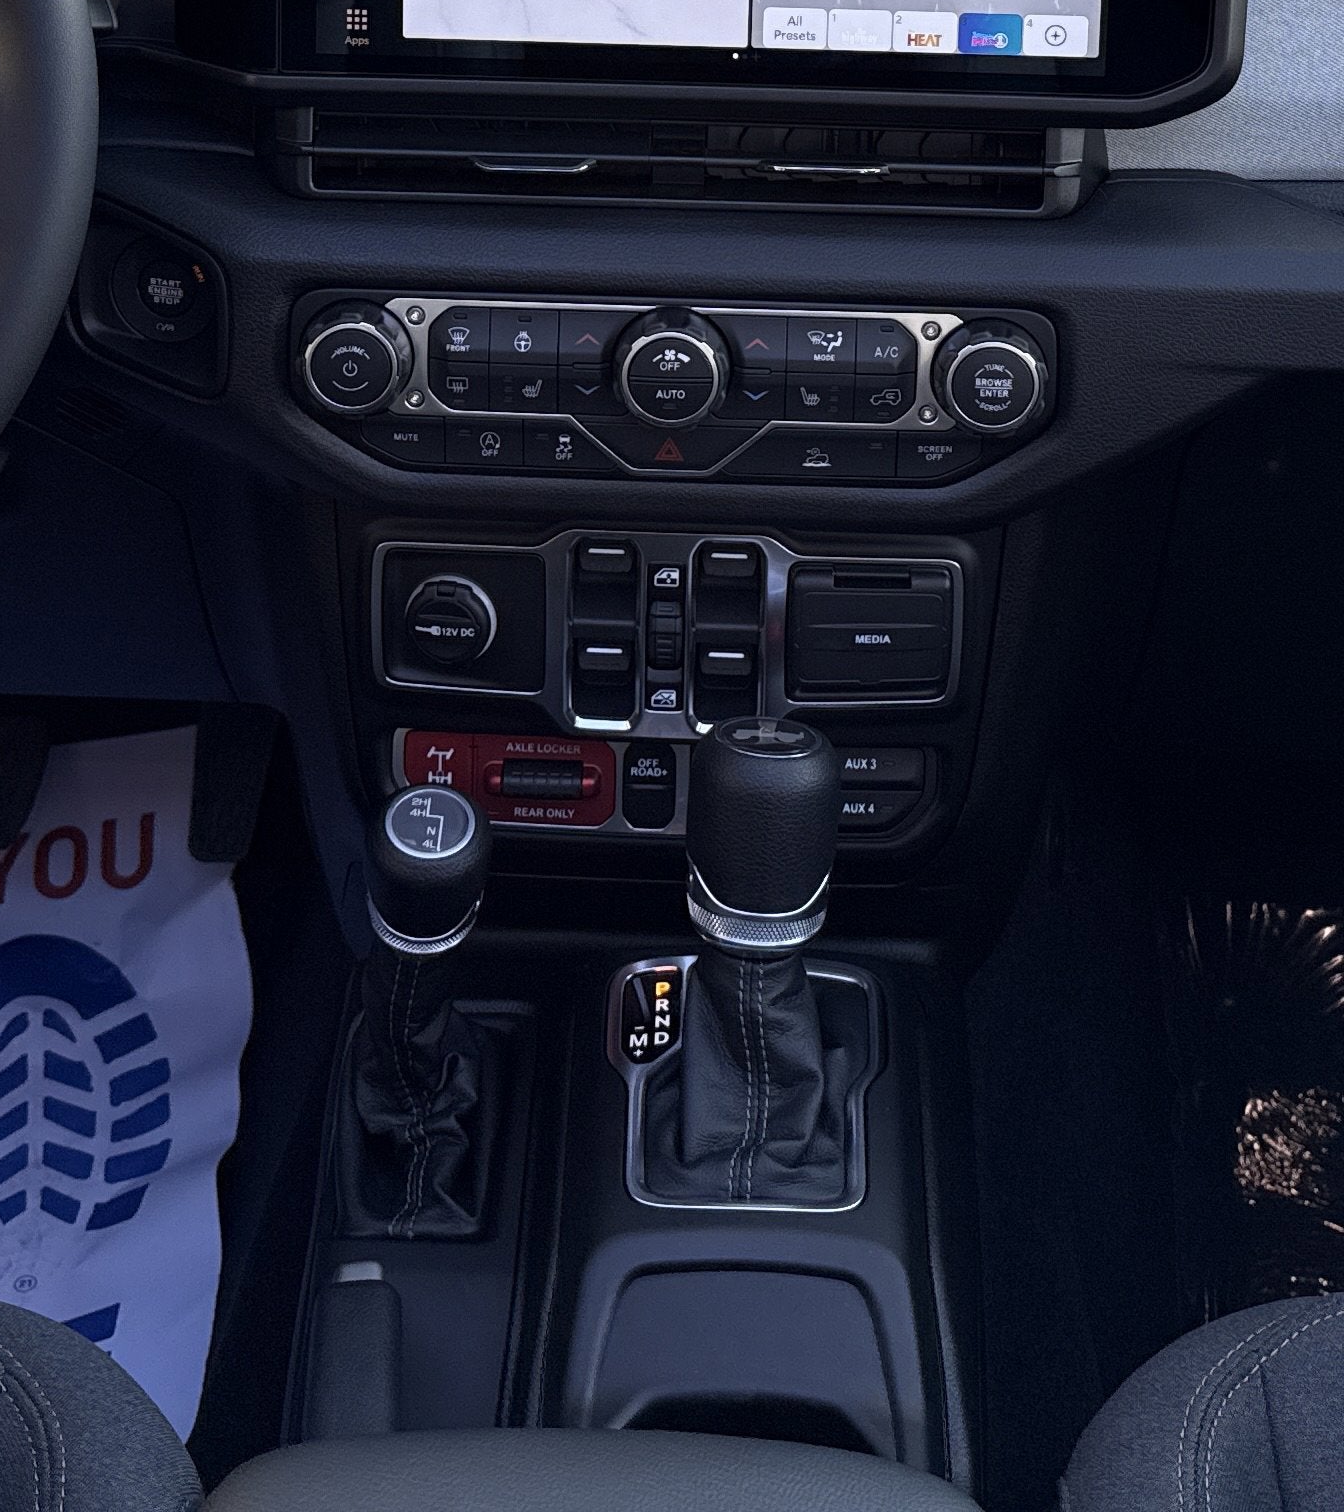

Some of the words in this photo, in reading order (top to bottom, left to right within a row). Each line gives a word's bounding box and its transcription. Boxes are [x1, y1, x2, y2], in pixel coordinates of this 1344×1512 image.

[788, 14, 803, 26] All
[895, 15, 902, 25] 2
[1026, 19, 1033, 27] 4
[344, 35, 370, 47] Apps
[774, 30, 816, 42] Presets
[907, 33, 942, 47] HEAT
[150, 277, 181, 287] START
[148, 285, 184, 298] ENGINE
[153, 295, 180, 305] STOP
[334, 345, 366, 356] VOLUME
[446, 344, 471, 352] FRONT
[874, 345, 899, 359] A/C
[813, 353, 836, 362] MODE
[659, 361, 681, 371] OFF
[975, 377, 1013, 387] BROWSE
[655, 389, 686, 400] AUTO
[979, 389, 1009, 399] ENTER
[978, 401, 1008, 412] SCROLL
[393, 432, 419, 442] MUTE
[481, 447, 499, 457] OFF
[917, 445, 953, 454] SCREEN
[555, 451, 573, 461] OFF
[925, 452, 943, 461] OFF
[441, 626, 459, 637] 12V
[460, 627, 475, 638] DC
[854, 633, 891, 645] MEDIA
[505, 742, 532, 754] AXLE
[534, 743, 581, 755] LOCKER
[637, 758, 660, 770] OFF
[844, 758, 864, 770] AUX
[869, 758, 877, 770] 3
[630, 766, 668, 777] ROAD+
[411, 797, 427, 806] 2H
[409, 808, 426, 817] 4H
[513, 807, 540, 819] REAR
[542, 807, 576, 820] ONLY
[843, 802, 862, 814] AUX
[866, 802, 875, 814] 4
[426, 826, 436, 836] N
[422, 839, 436, 849] 4L
[655, 981, 671, 997] P
[655, 998, 670, 1013] R
[655, 1014, 671, 1029] N
[629, 1033, 648, 1048] M
[654, 1031, 669, 1045] D
